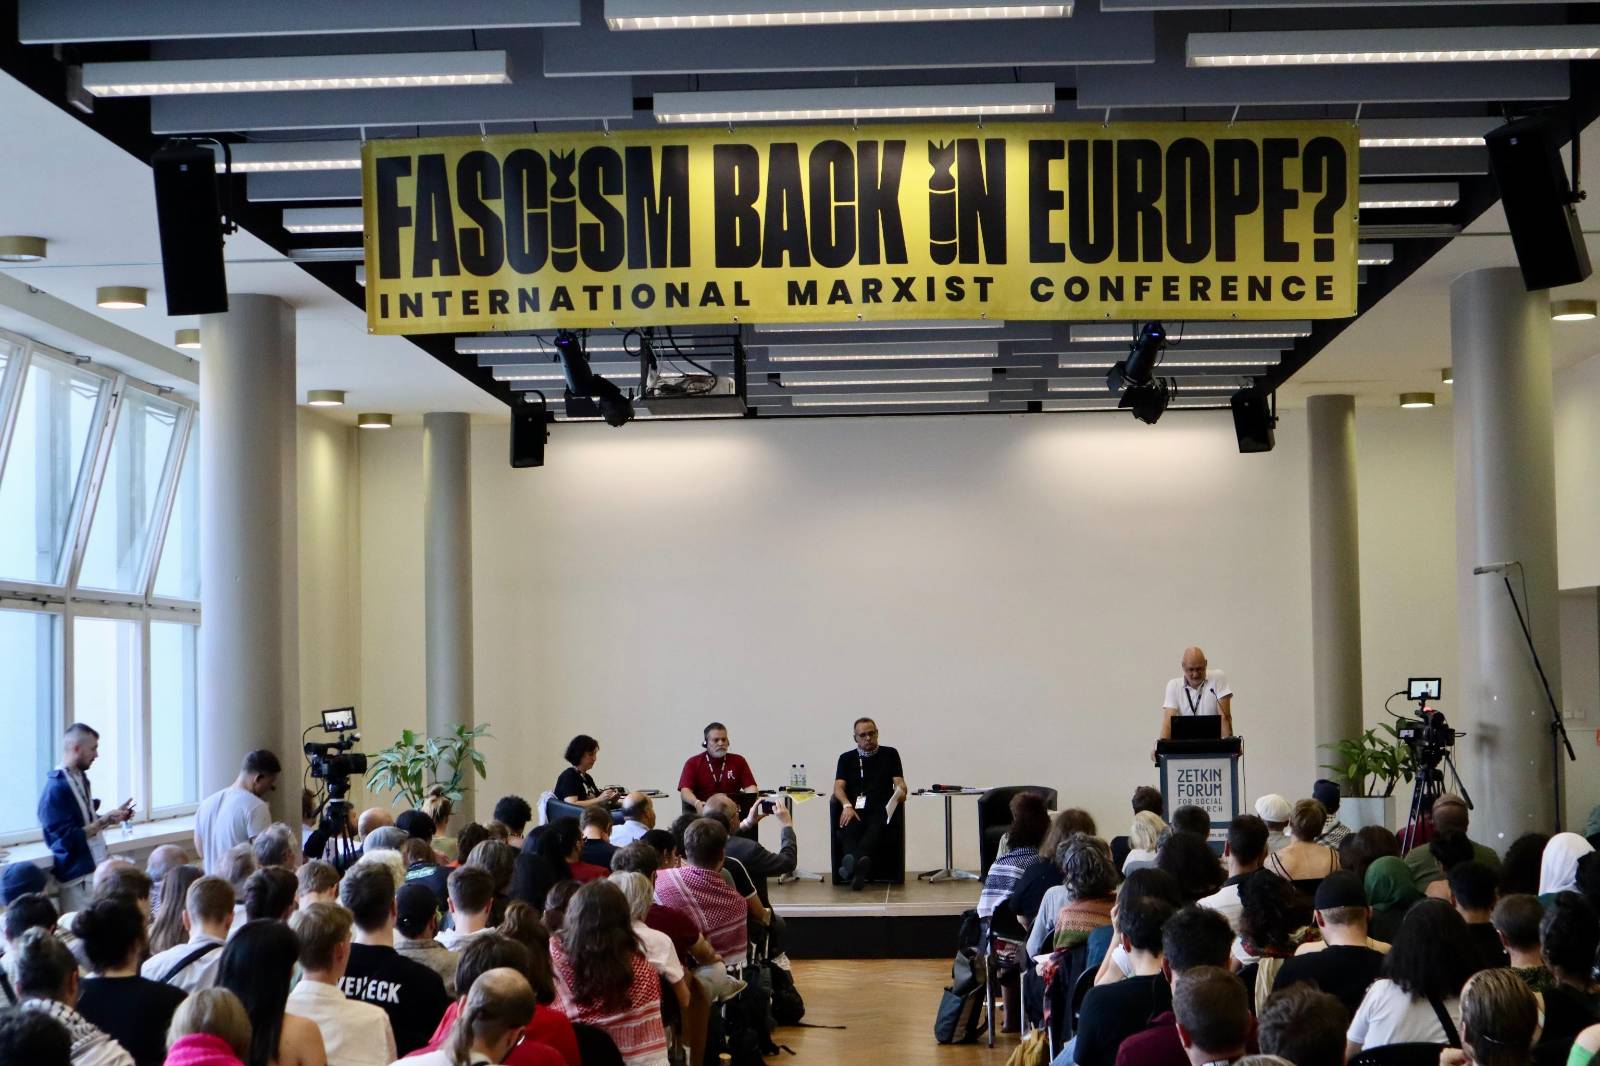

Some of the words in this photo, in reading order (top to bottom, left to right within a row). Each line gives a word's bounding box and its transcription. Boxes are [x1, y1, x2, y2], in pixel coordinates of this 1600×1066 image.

[376, 145, 691, 280] FASCISM
[713, 139, 909, 269] BACK
[928, 138, 1007, 266] IN
[1028, 136, 1347, 265] EUROPE?
[380, 281, 750, 318] INTERNATIONAL
[787, 276, 994, 306] MARXIST
[1030, 275, 1334, 302] CONFERENCE
[1177, 768, 1222, 783] ZETKIN
[1177, 784, 1222, 797] FORUM
[1195, 797, 1222, 805] SOCIAL
